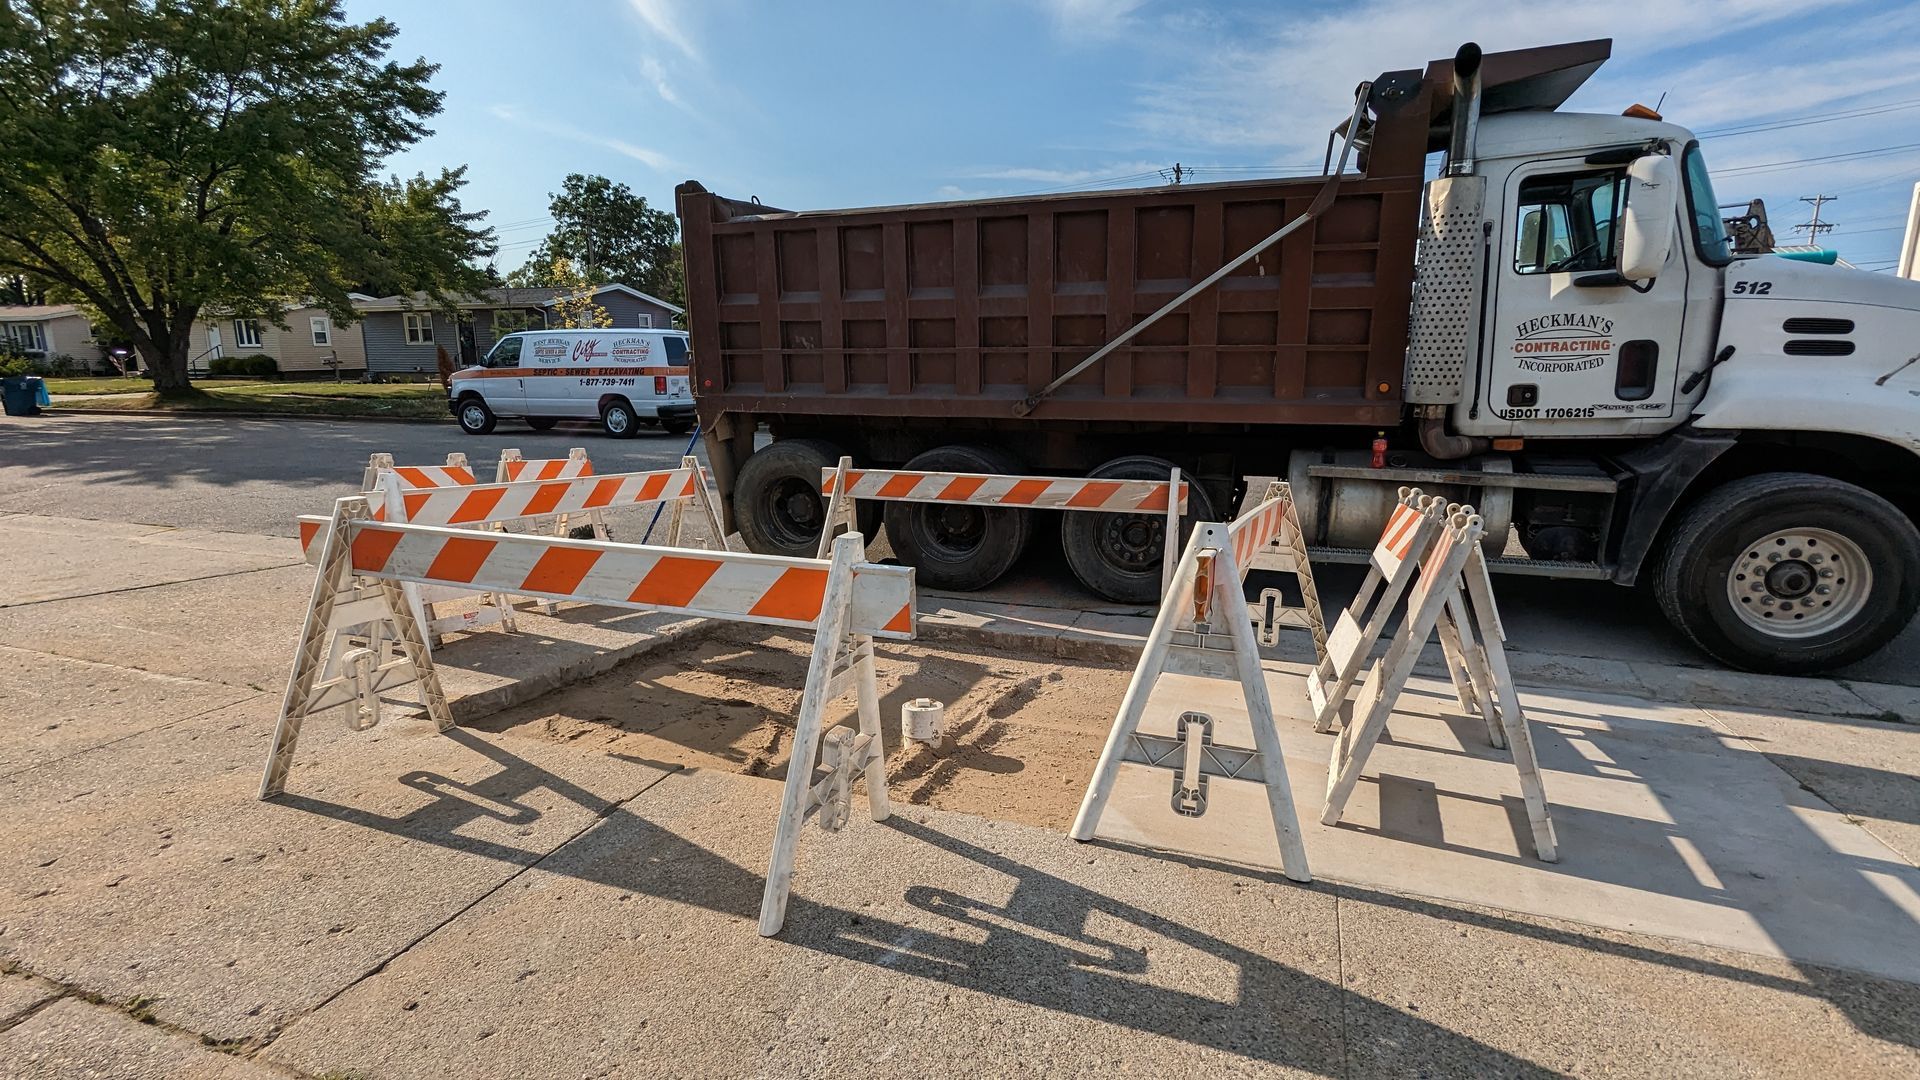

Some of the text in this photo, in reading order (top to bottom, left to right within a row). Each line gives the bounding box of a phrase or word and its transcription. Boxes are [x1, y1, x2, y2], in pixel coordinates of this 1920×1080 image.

[1732, 281, 1773, 295] 512
[1516, 313, 1614, 338] HECKMAN'S
[613, 337, 651, 348] HECKMAN'S
[1514, 340, 1611, 353] CONTRACTING
[572, 339, 602, 362] City
[533, 366, 645, 376] SEPTIC SEWER EXCAVATING
[1518, 357, 1604, 373] INCORPORATED
[579, 378, 635, 386] 1-877-739-7411
[1500, 408, 1595, 419] USDOT 1706215
